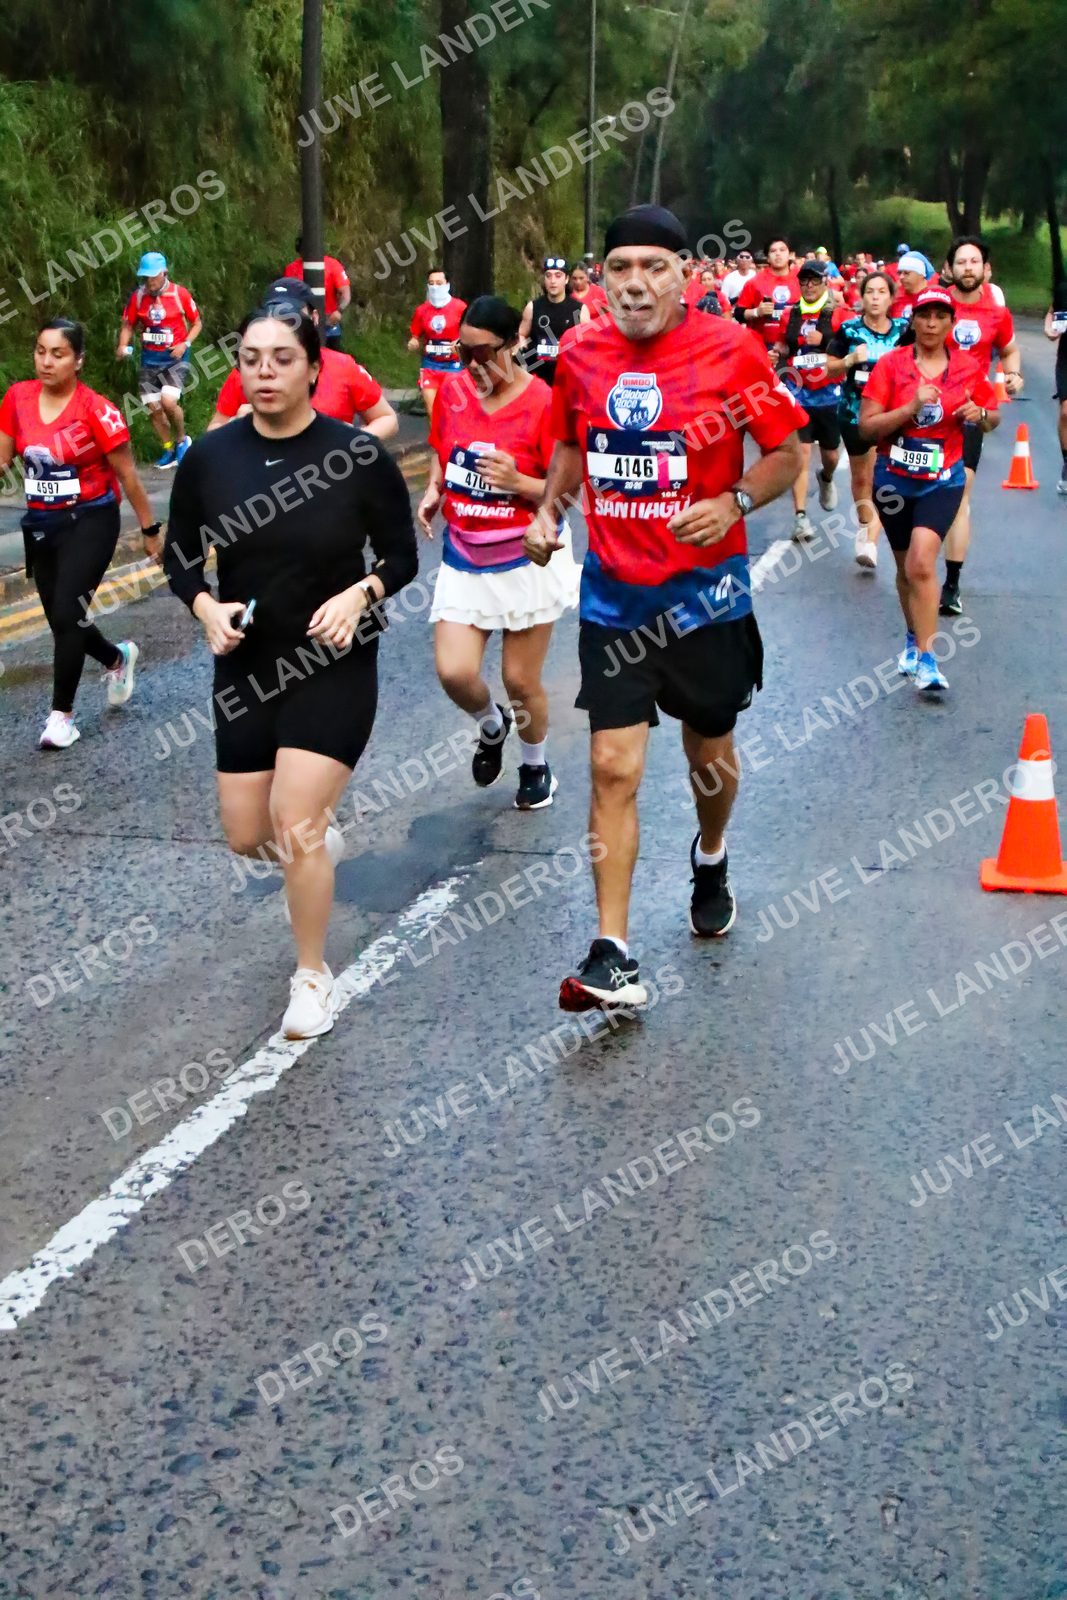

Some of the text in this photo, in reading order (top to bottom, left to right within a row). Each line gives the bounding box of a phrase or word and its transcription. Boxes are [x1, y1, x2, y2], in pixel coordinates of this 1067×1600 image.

[622, 378, 651, 386] BIMBO
[621, 389, 650, 400] Global
[615, 399, 637, 408] Race
[902, 451, 929, 465] 3999
[614, 457, 654, 478] 4146
[36, 482, 60, 494] 4597
